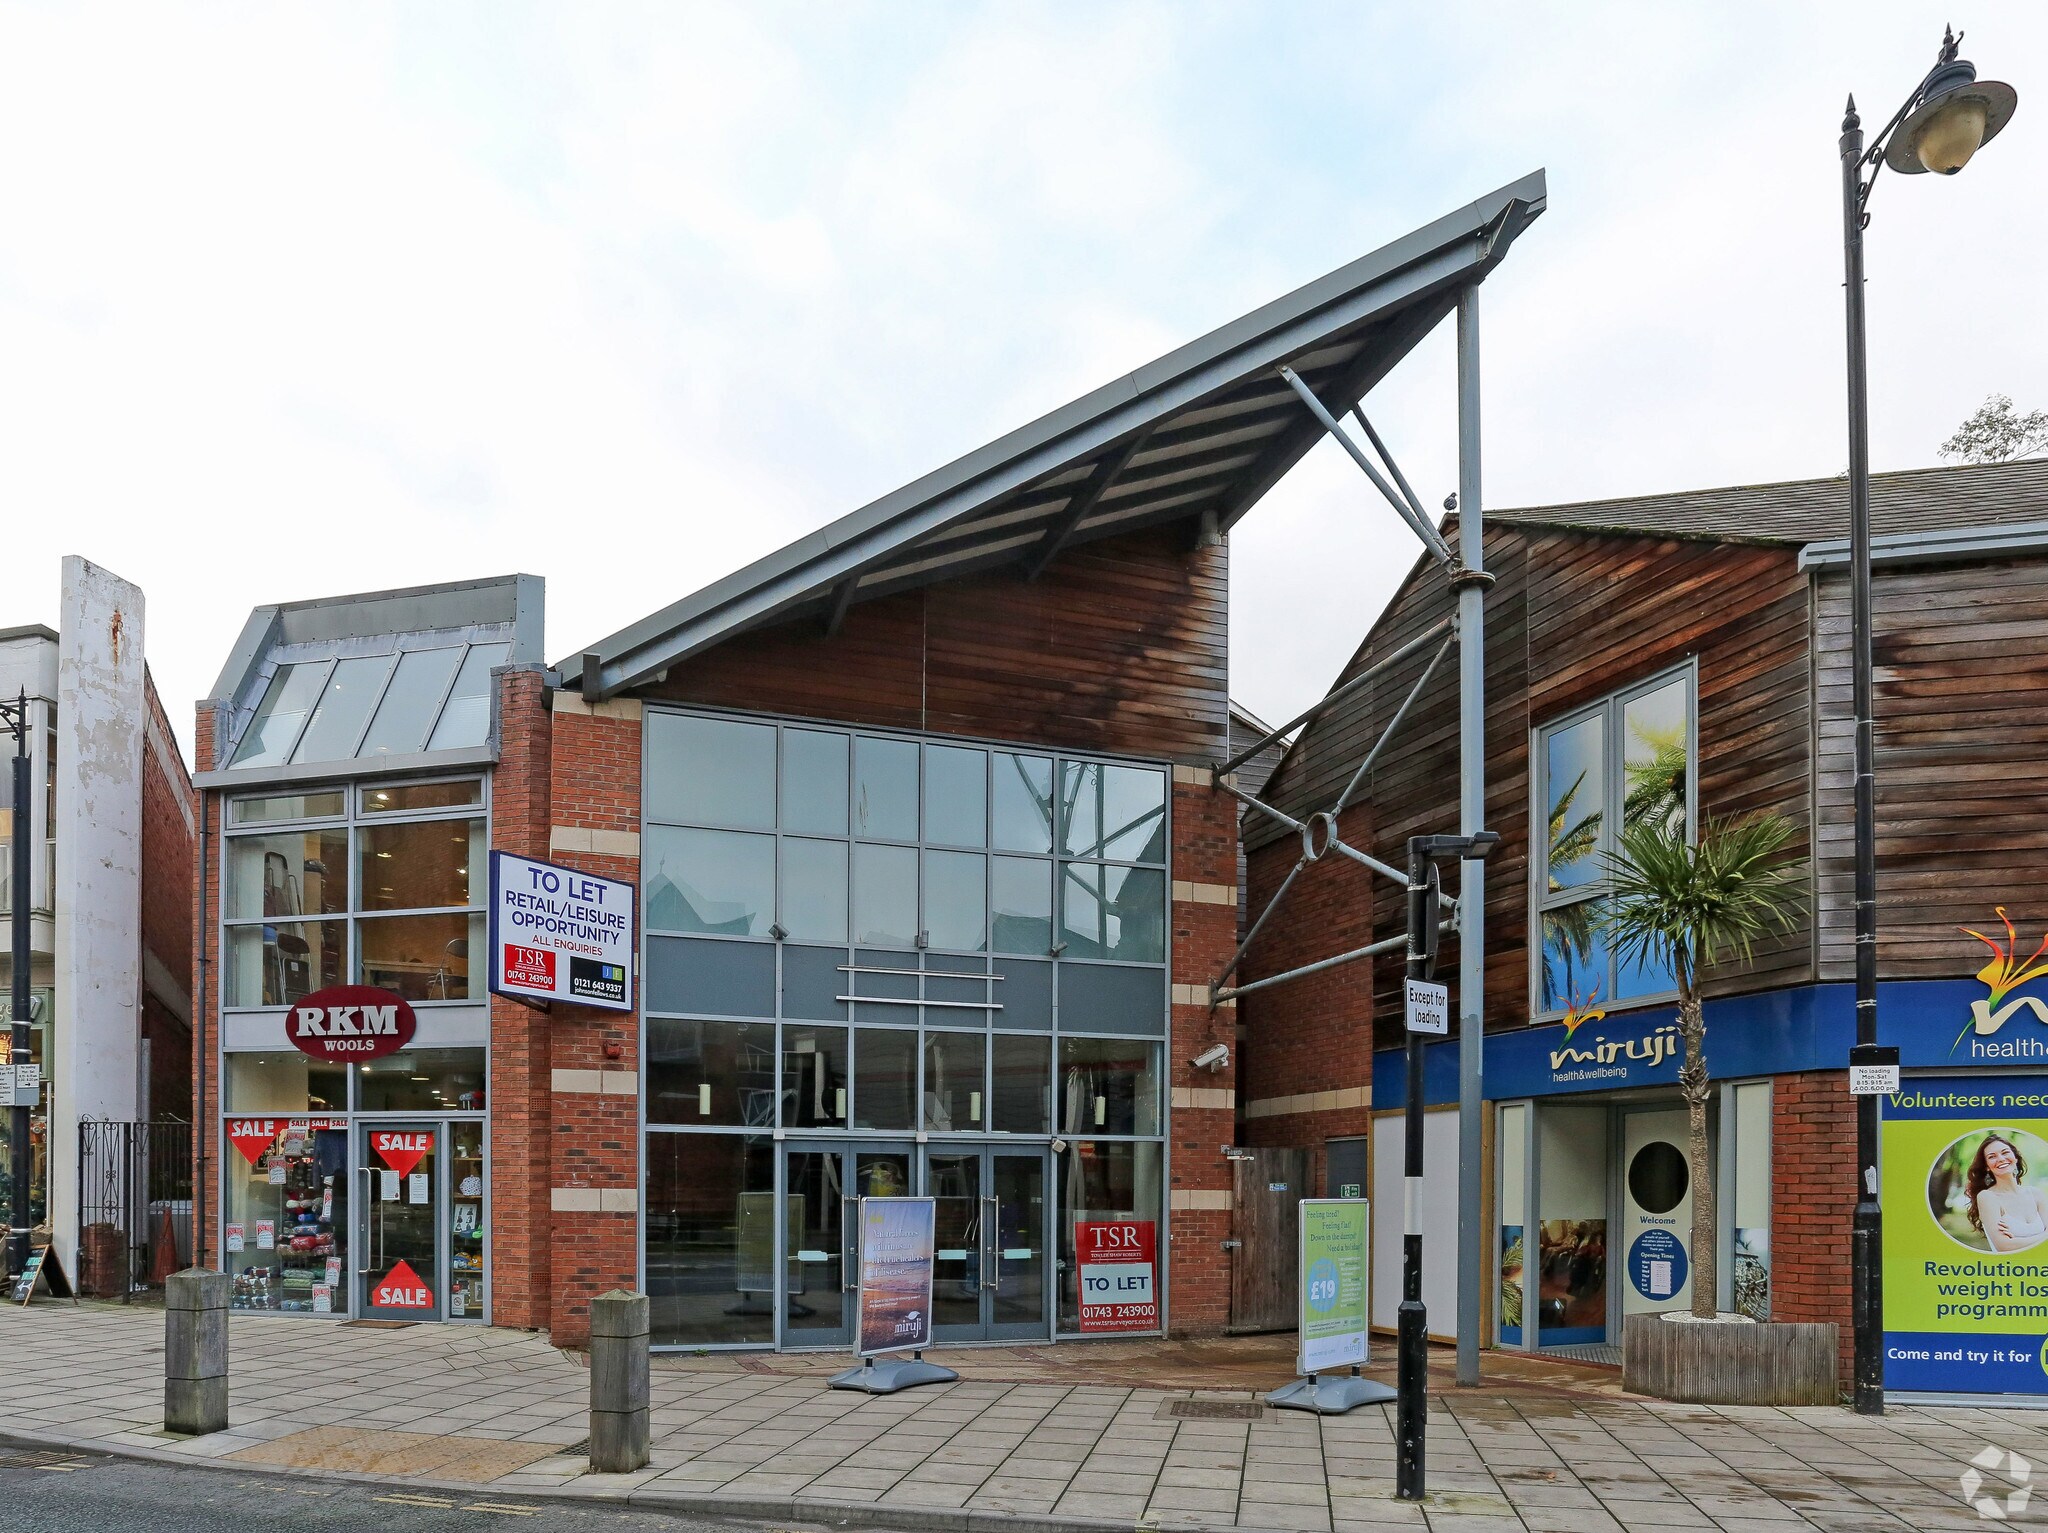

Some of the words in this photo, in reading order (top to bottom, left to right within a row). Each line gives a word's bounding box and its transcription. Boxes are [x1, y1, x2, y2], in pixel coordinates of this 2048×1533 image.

[527, 867, 560, 894] TO
[568, 877, 607, 904] LET
[505, 889, 626, 930] RETAIL/LEISURE
[511, 910, 620, 946] OPPORTUNITY
[532, 934, 551, 946] ALL
[554, 938, 603, 956] ENQUIRIES
[514, 947, 546, 967] TSR
[507, 969, 526, 981] 01743
[528, 973, 553, 985] 243900
[574, 977, 590, 988] 0121
[592, 980, 605, 991] 643
[605, 983, 622, 993] 9337
[1409, 986, 1434, 1007] Except
[1435, 991, 1446, 1007] for
[296, 1004, 399, 1037] RKM
[1415, 1008, 1441, 1028] loading
[323, 1039, 375, 1051] WOOLS
[1549, 1025, 1676, 1070] miruji
[1553, 1067, 1627, 1082] health&wellbeing
[1889, 1091, 1996, 1108] Volunteers
[231, 1119, 275, 1137] SALE
[291, 1119, 308, 1127] SALE
[311, 1119, 328, 1127] SALE
[332, 1119, 348, 1127] SALE
[379, 1134, 427, 1151] SALE
[1639, 1215, 1676, 1225] Welcome
[1089, 1226, 1142, 1248] TSR
[1084, 1277, 1110, 1291] TO
[1117, 1276, 1149, 1290] LET
[1310, 1279, 1336, 1301] £19
[1937, 1280, 2013, 1301] weight
[379, 1287, 427, 1305] SALE
[1082, 1306, 1112, 1318] 01743
[1116, 1305, 1155, 1317] 243900
[1937, 1303, 2048, 1321] programm
[1083, 1318, 1155, 1326] www.tsrsurveyors.co.uk
[1887, 1348, 1930, 1360] Come
[1934, 1349, 1963, 1361] and
[1967, 1350, 1989, 1364] try
[1993, 1350, 2005, 1362] it
[2007, 1350, 2032, 1363] for
